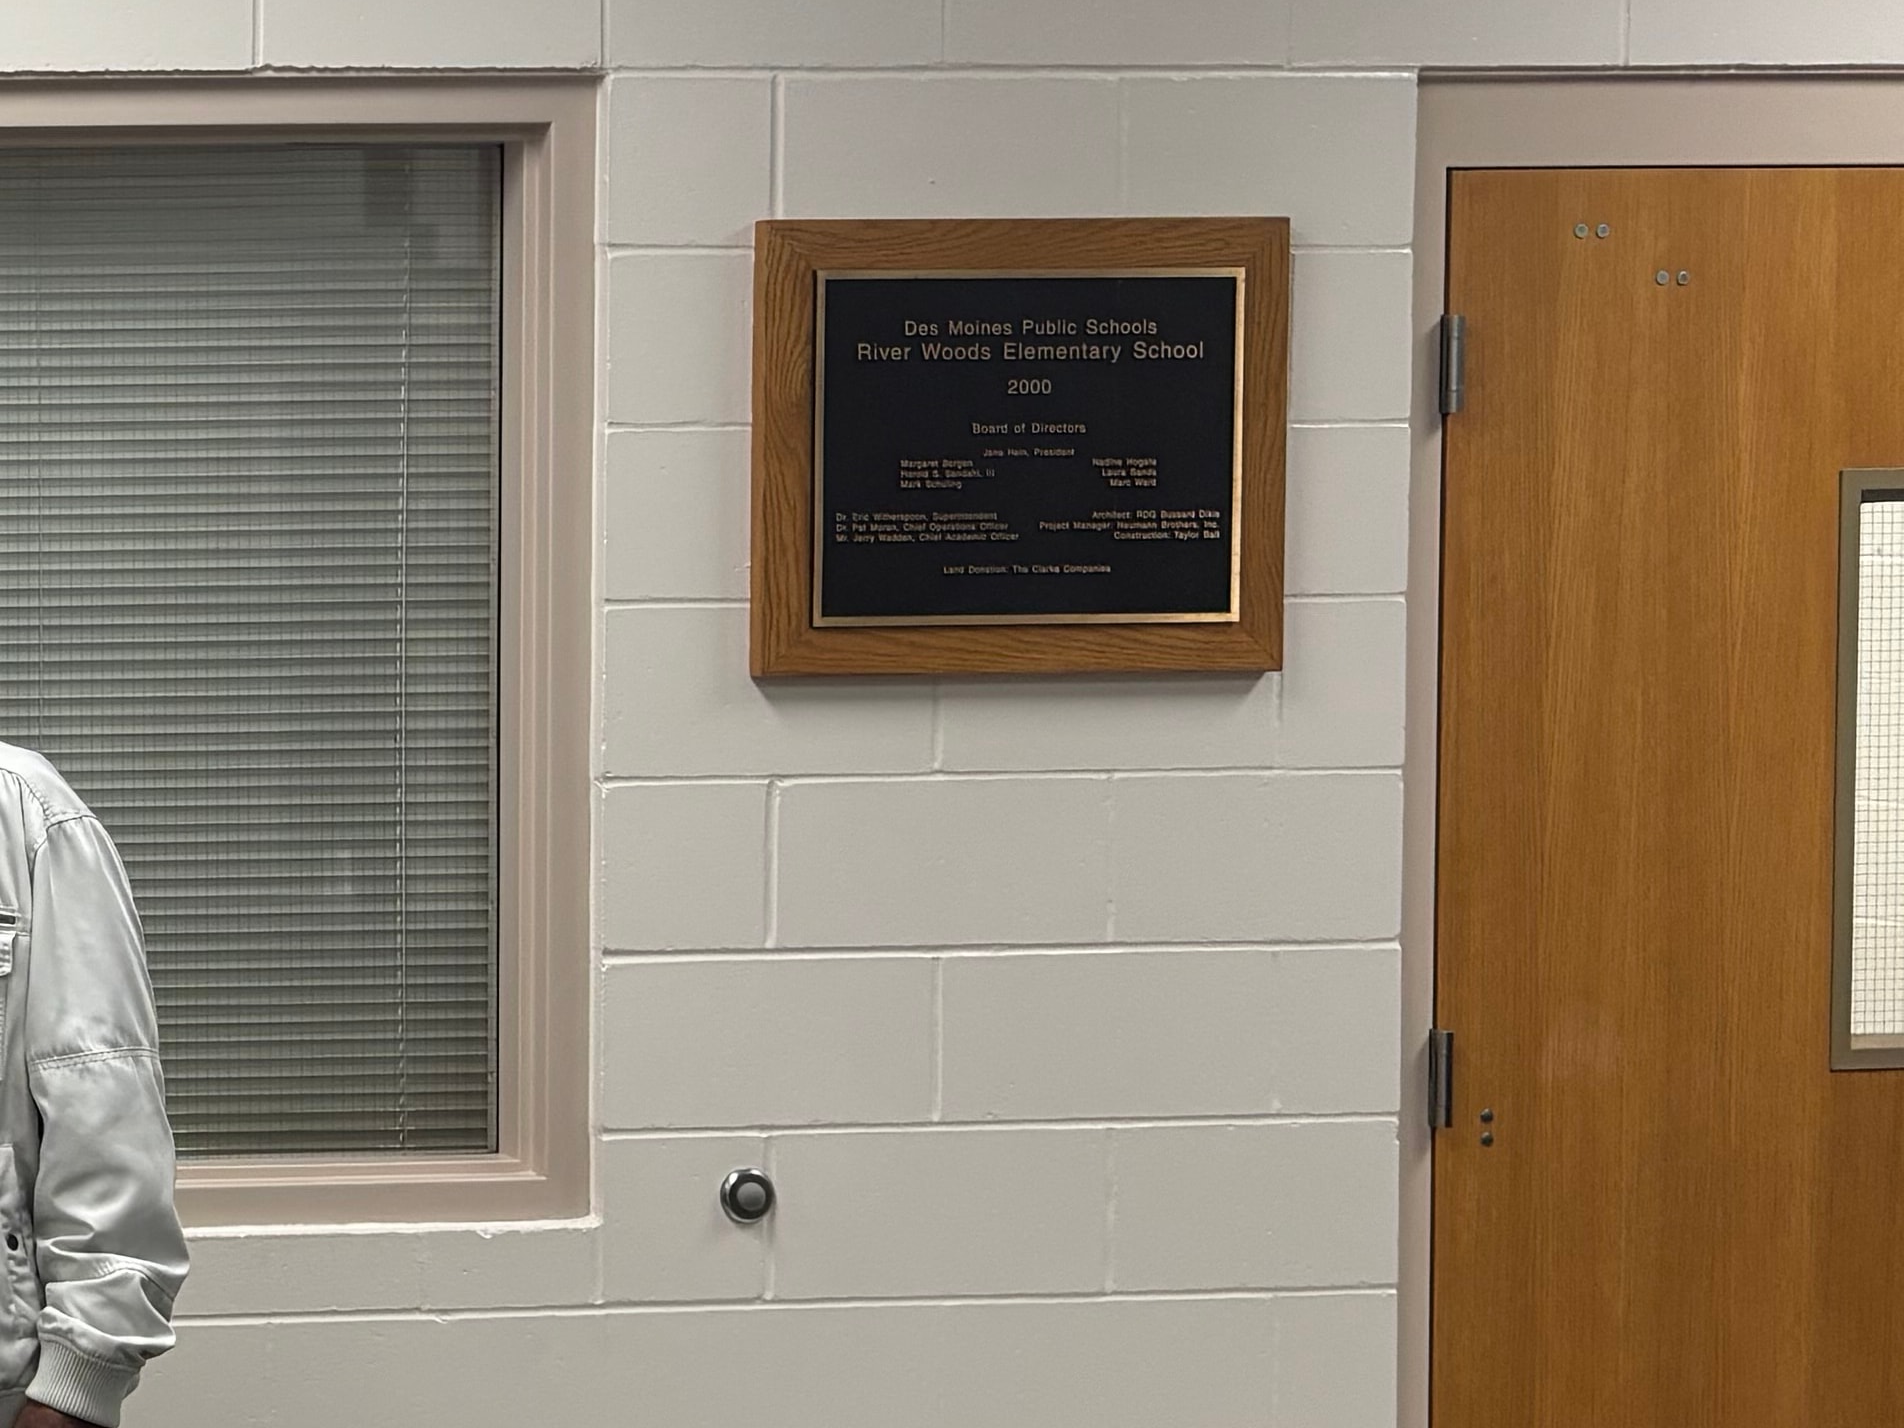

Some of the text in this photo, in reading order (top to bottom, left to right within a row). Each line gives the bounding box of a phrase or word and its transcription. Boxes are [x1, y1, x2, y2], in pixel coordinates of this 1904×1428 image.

[905, 319, 1157, 336] Des Moines Public Schools
[858, 341, 1203, 363] River Woods Elementary School
[1008, 379, 1052, 394] 2000
[972, 423, 1086, 434] Board of Directors
[1034, 448, 1075, 456] President
[900, 460, 938, 469] Margaret
[900, 480, 921, 488] Mark
[903, 523, 926, 531] Chief
[929, 523, 976, 532] Operations
[980, 523, 1008, 531] Officer
[1039, 522, 1069, 532] Project
[919, 533, 942, 541] Chief
[990, 532, 1019, 540] Officer
[1114, 531, 1170, 539] Construction:
